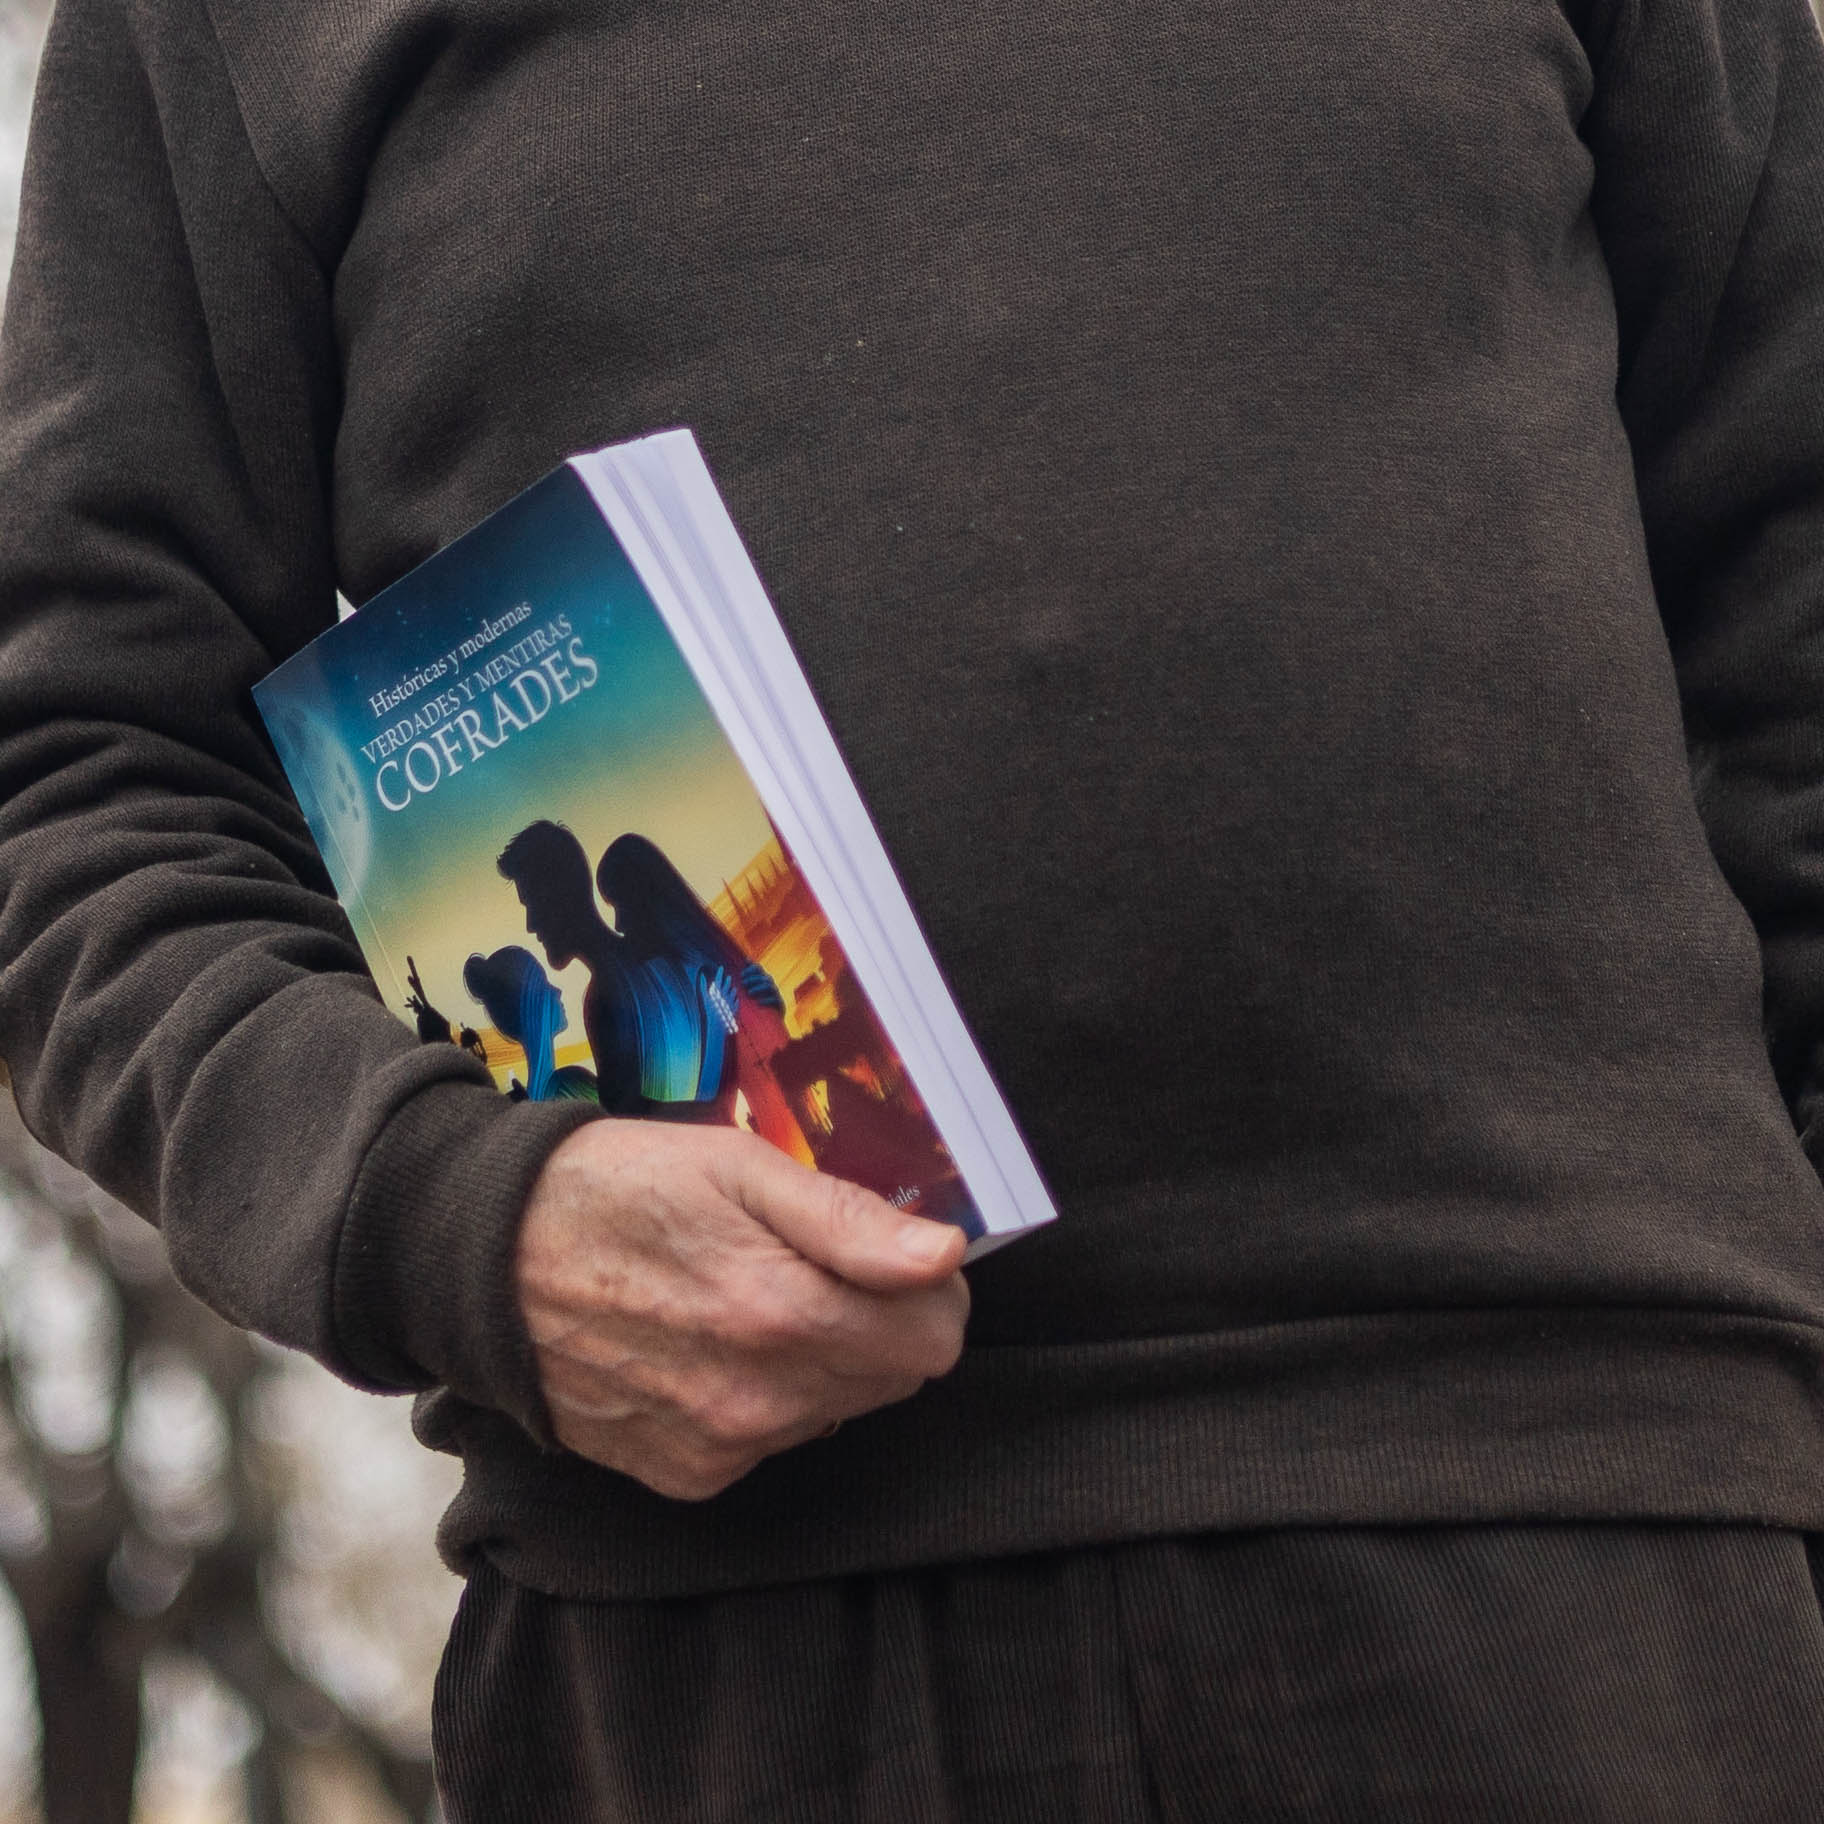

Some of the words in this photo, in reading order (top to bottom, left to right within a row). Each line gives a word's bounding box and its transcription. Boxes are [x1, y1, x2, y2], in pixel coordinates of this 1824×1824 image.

[360, 688, 461, 764] VERDADES
[457, 678, 475, 701] Y
[473, 613, 572, 692] MENTIRAS
[368, 658, 448, 717] Históricas
[447, 651, 460, 674] y
[459, 601, 532, 659] modernas
[376, 637, 598, 811] COFRADES
